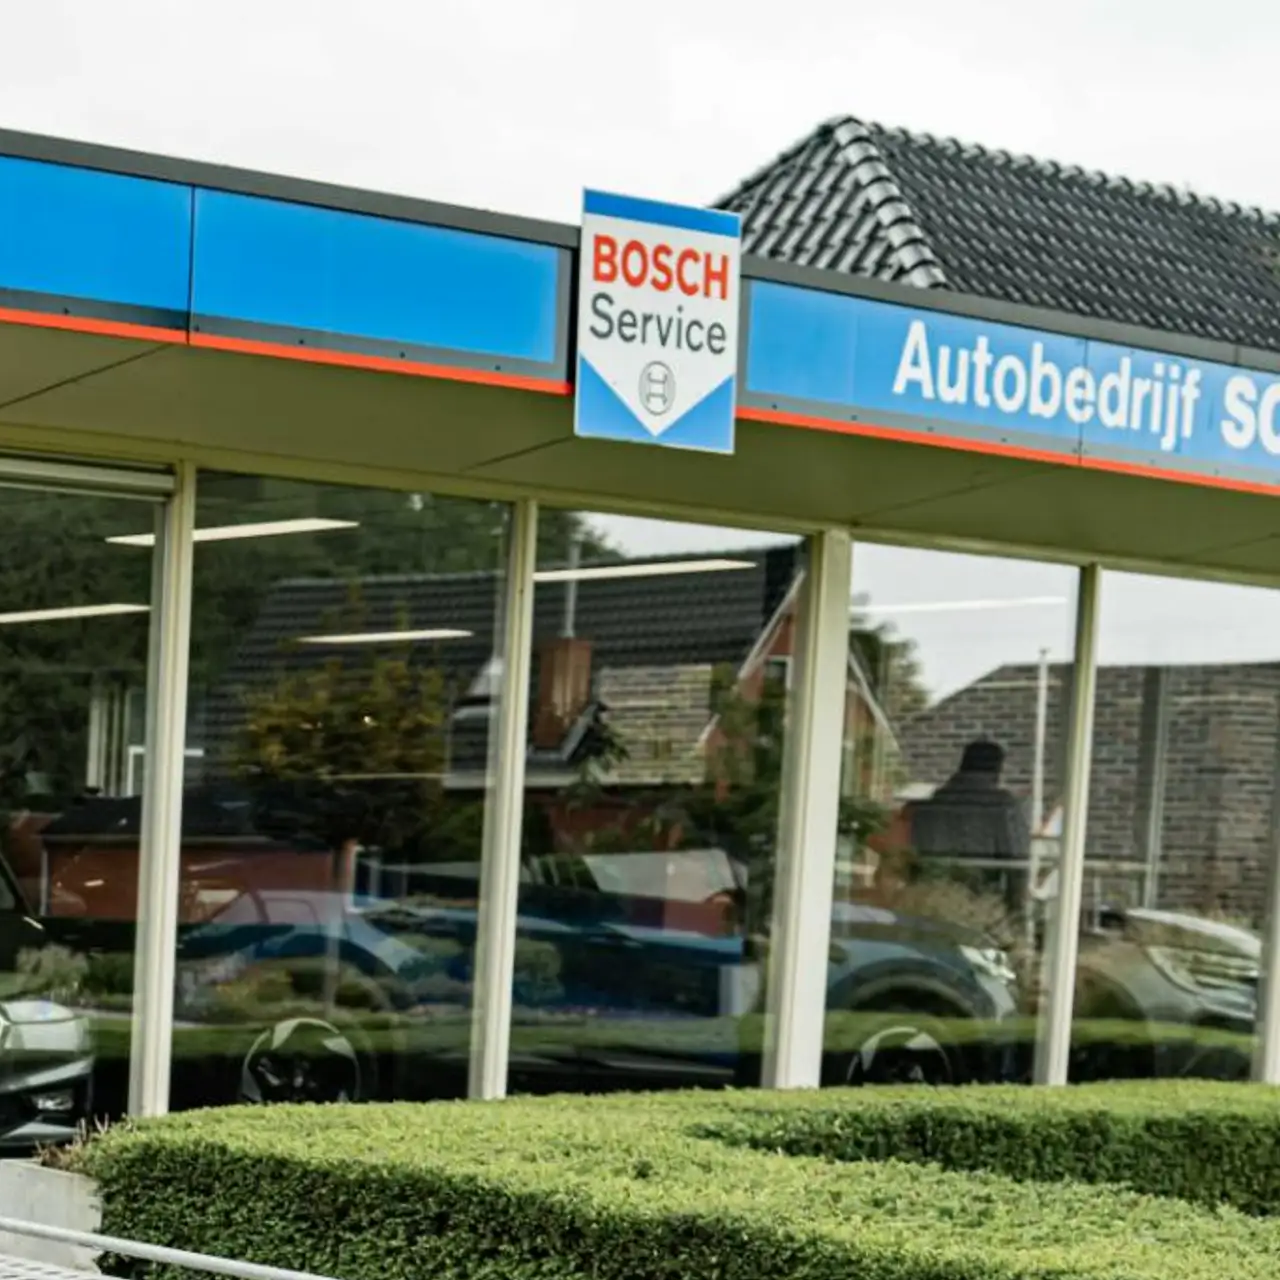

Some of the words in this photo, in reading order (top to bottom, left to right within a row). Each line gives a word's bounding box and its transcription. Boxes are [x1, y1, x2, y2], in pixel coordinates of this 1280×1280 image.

[591, 233, 730, 301] BOSCH
[588, 291, 728, 356] Service
[892, 319, 1202, 453] Autobedrijf
